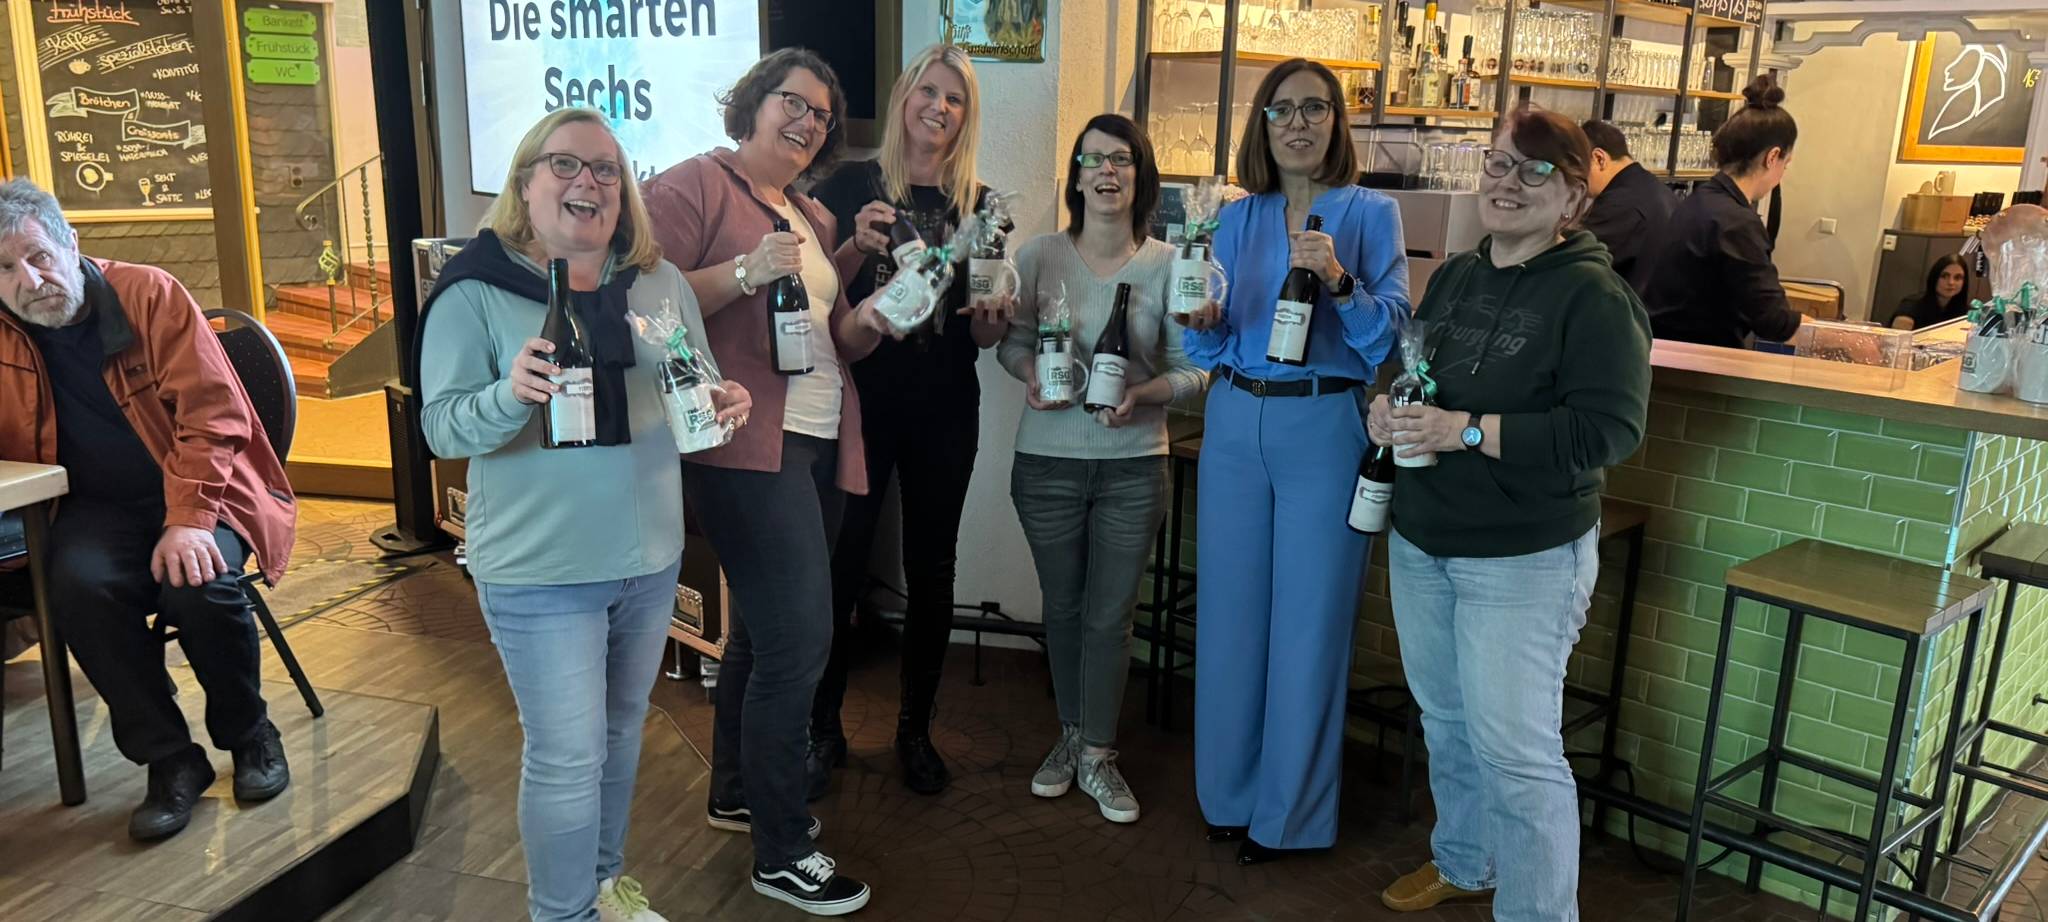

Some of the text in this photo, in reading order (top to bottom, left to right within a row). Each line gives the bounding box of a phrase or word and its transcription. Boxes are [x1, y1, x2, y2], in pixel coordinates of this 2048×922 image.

[263, 15, 304, 27] Bankett
[490, 0, 717, 40] Die smarten
[256, 41, 311, 54] Frühstück
[274, 66, 296, 78] WC
[544, 64, 652, 121] Sechs
[78, 93, 131, 109] Brötchen
[60, 151, 110, 163] SPIEGELEI
[1182, 281, 1204, 292] RSG
[1050, 370, 1070, 380] RSG
